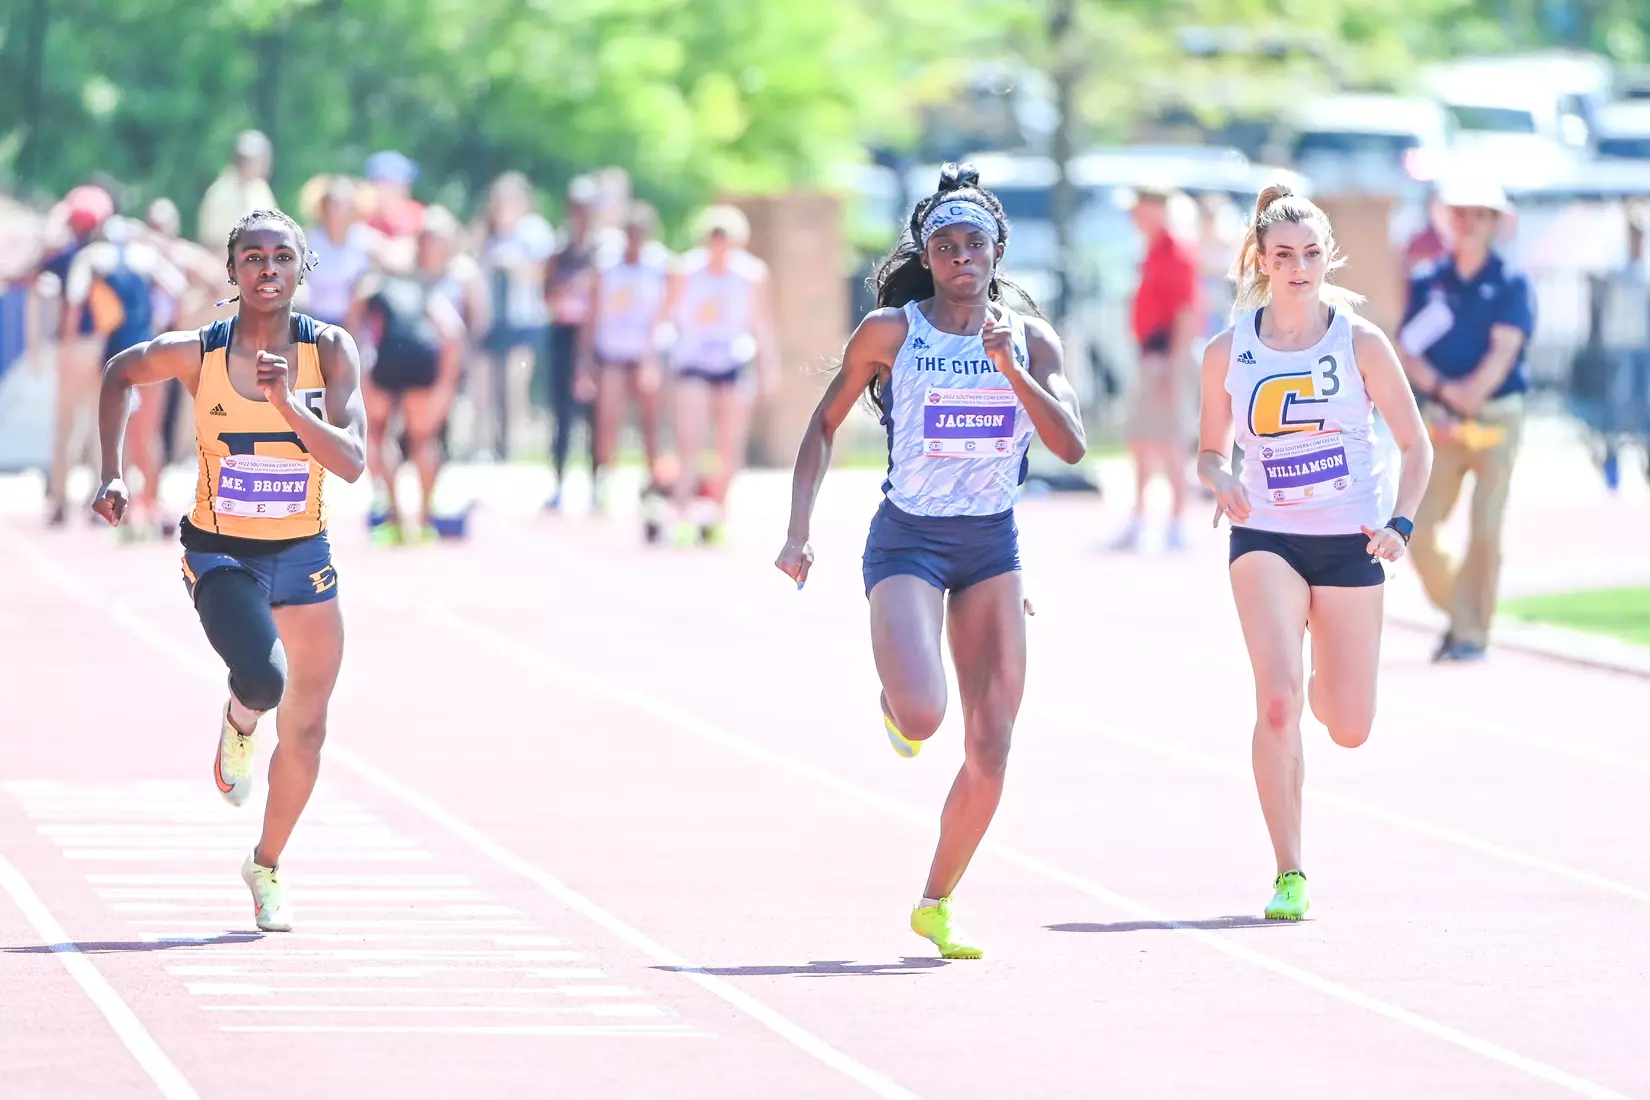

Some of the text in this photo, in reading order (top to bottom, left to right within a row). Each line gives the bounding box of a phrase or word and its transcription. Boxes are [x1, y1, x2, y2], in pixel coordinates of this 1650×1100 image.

[949, 206, 963, 216] C
[915, 356, 947, 372] THE
[1318, 354, 1340, 396] 3
[935, 414, 1005, 428] JACKSON
[1285, 441, 1310, 452] SOUTHERN
[1310, 436, 1340, 447] CONFERENCE
[1266, 454, 1344, 478] WILLIAMSON
[221, 476, 306, 493] ME. BROWN
[256, 503, 267, 513] E
